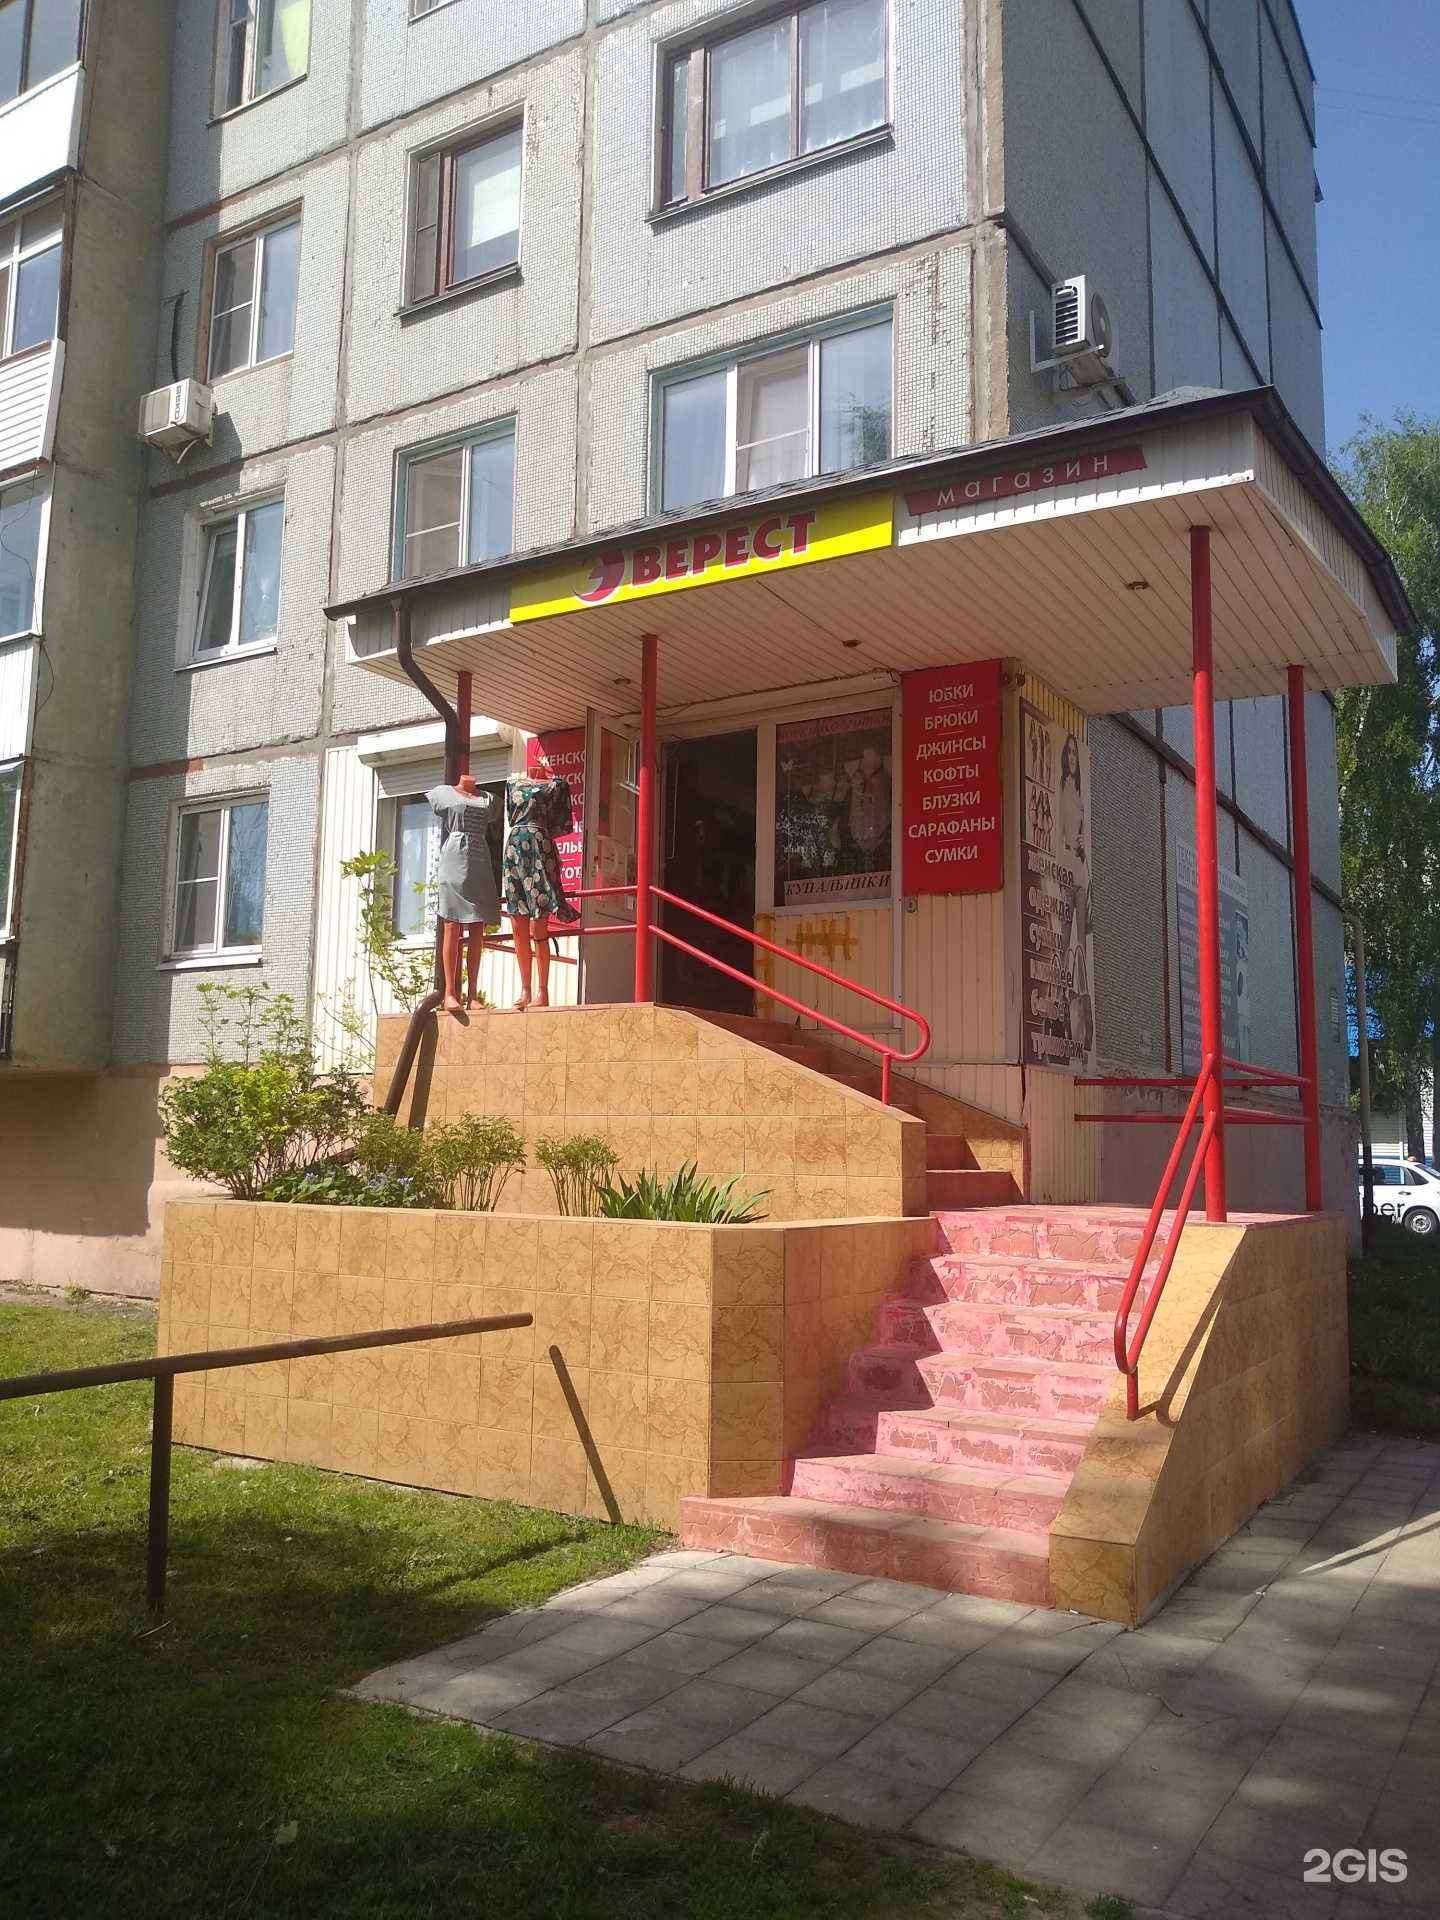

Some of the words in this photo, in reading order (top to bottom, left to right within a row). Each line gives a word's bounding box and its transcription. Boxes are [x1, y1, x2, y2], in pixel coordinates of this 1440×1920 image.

[937, 454, 1109, 506] магазин
[928, 683, 974, 704] ЮБКИ
[924, 709, 979, 731] БРЮКИ
[916, 735, 987, 760] ДЖИНСЫ
[922, 763, 980, 784] КОФТЫ
[922, 790, 981, 811] БЛУЗКИ
[908, 816, 996, 838] САРАФАНЫ
[924, 845, 979, 864] СУМКИ
